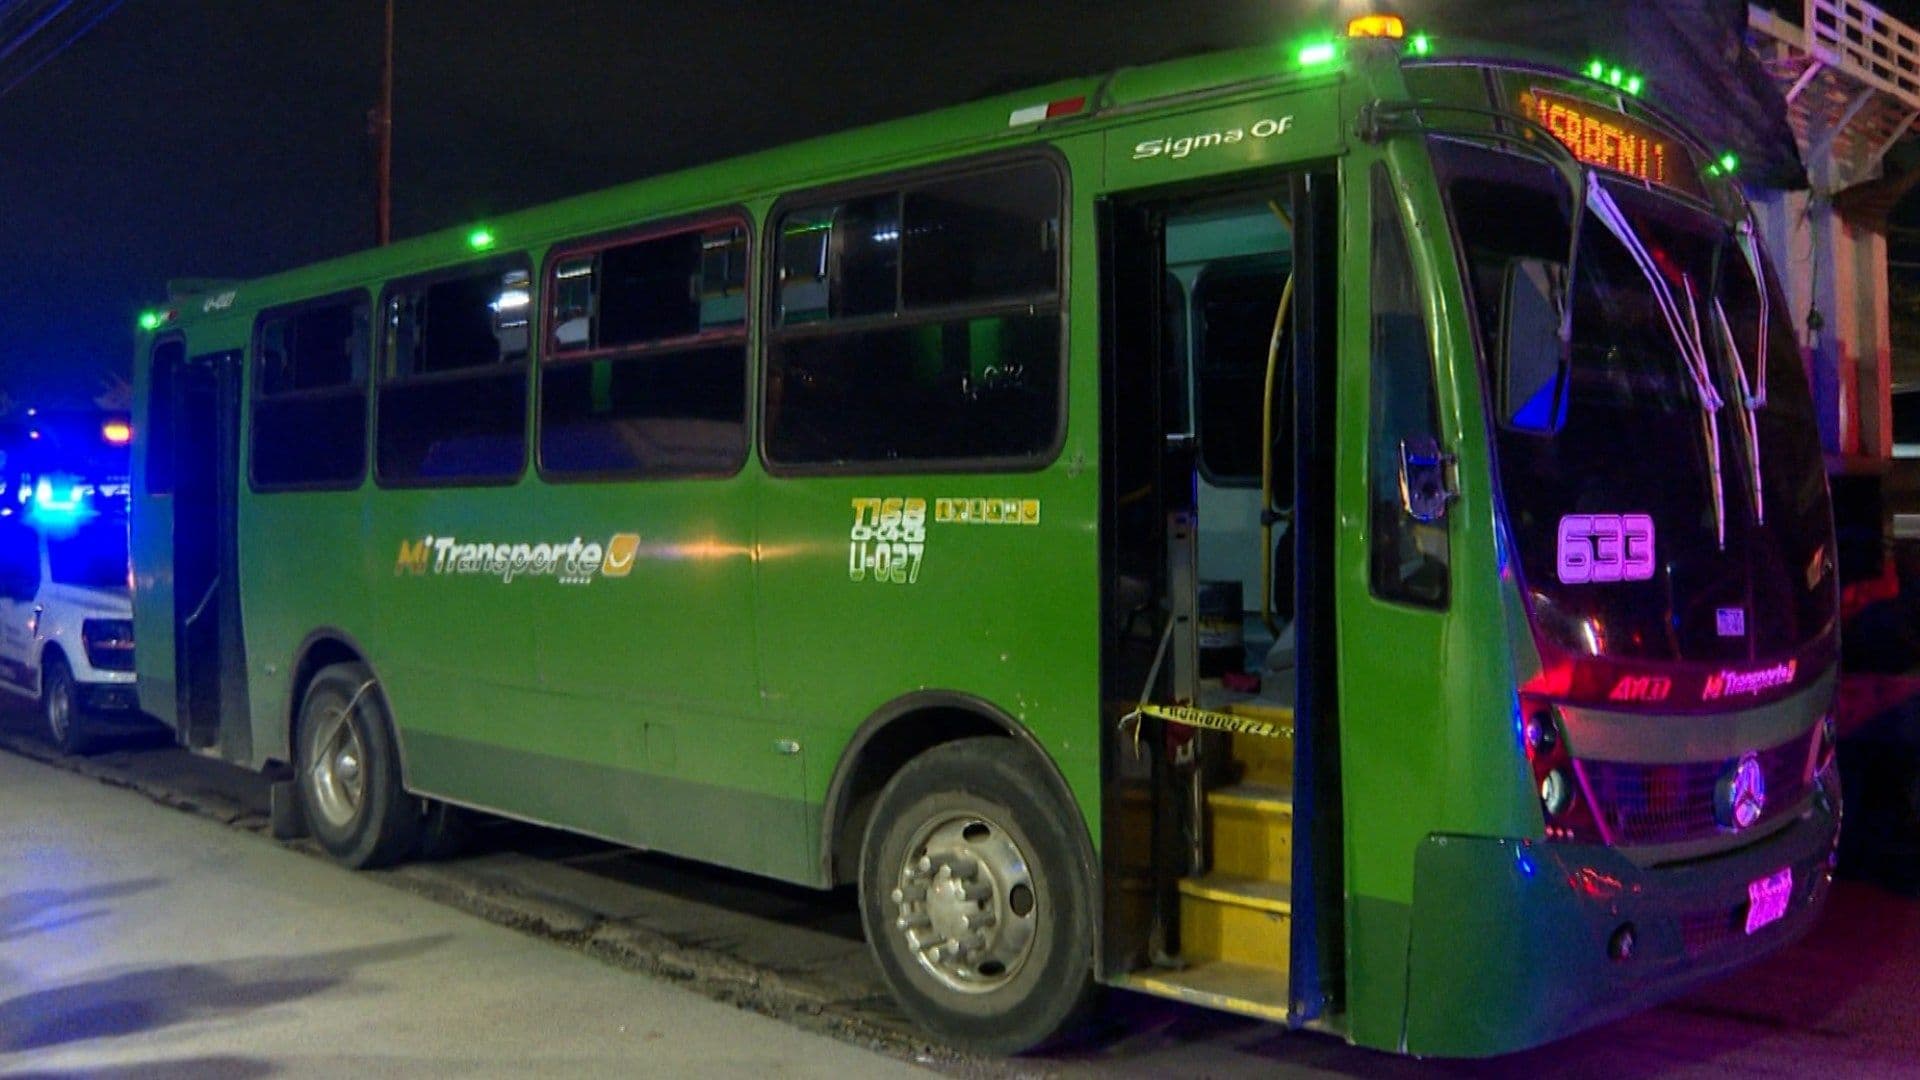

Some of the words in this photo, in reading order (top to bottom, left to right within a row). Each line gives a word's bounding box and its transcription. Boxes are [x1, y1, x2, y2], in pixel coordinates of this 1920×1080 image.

[1133, 127, 1245, 159] Sigma
[433, 536, 603, 584] Transporte
[850, 541, 925, 585] U-027
[1557, 514, 1655, 584] 633
